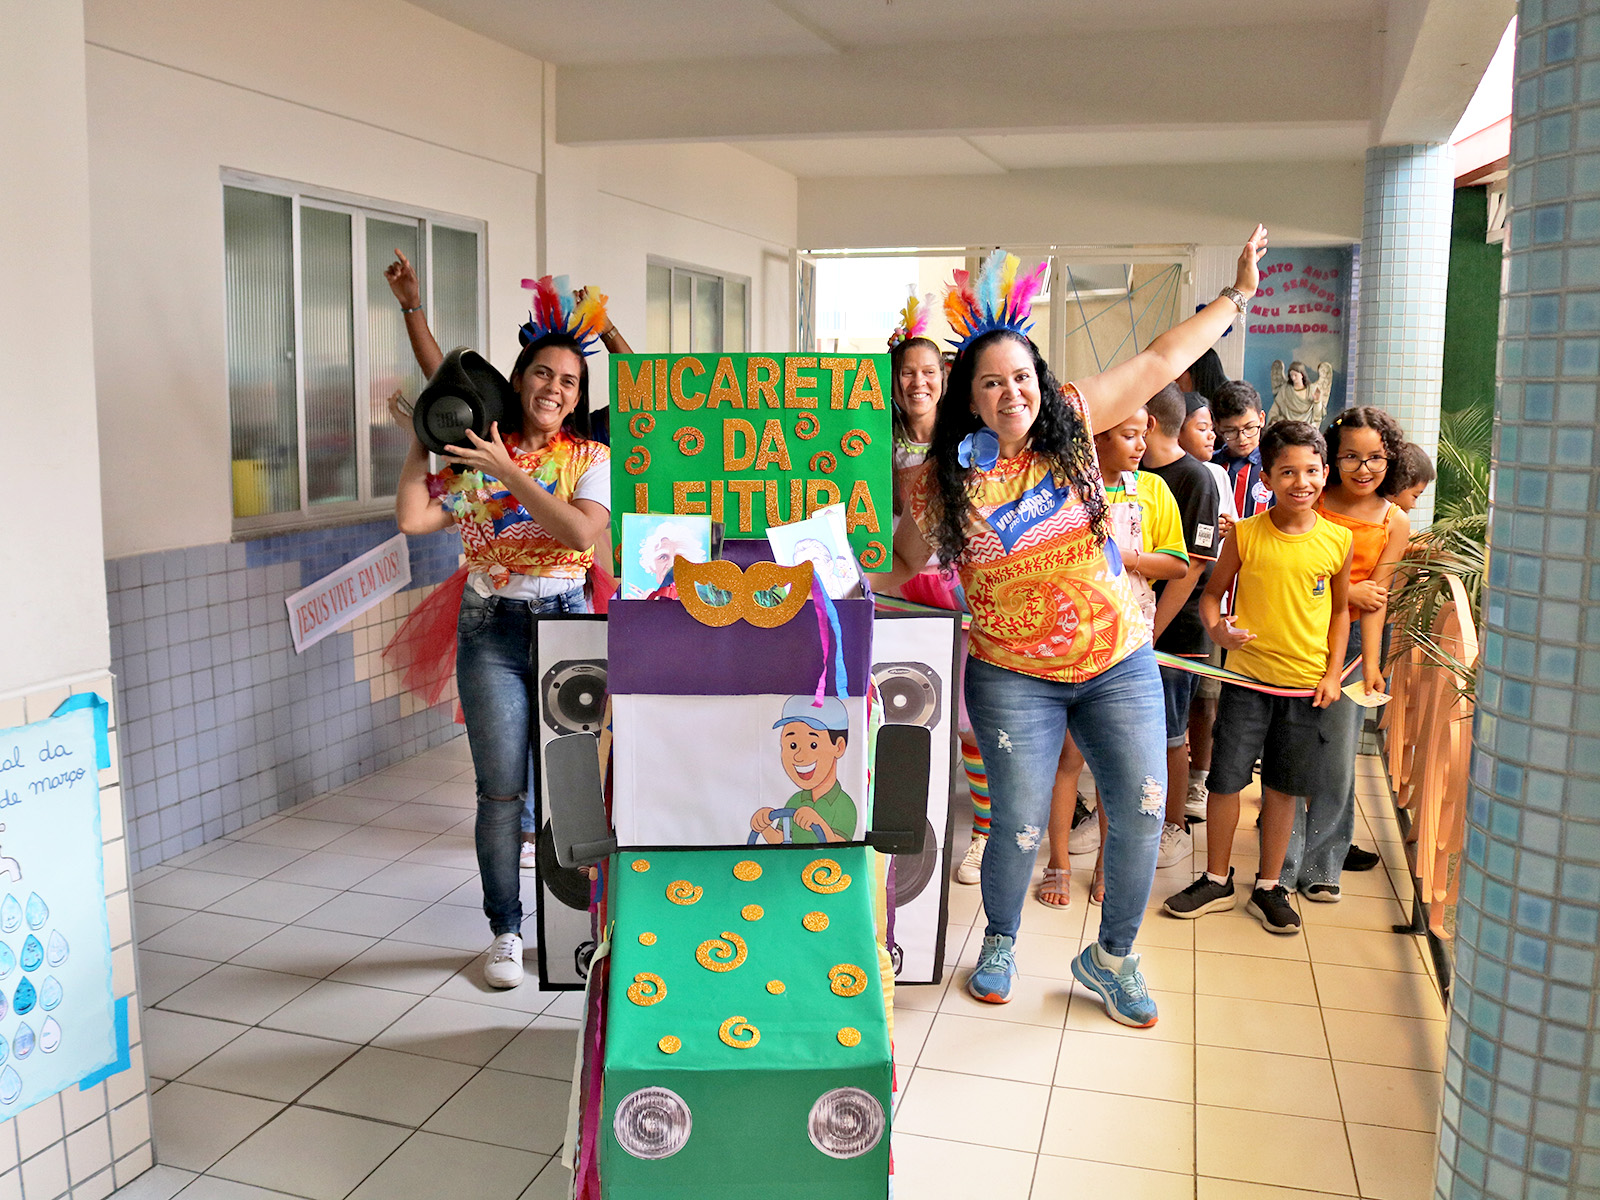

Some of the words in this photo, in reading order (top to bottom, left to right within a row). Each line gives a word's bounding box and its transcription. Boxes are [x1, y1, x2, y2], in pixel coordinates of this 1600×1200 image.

[1258, 262, 1294, 282] ANTO
[1255, 287, 1275, 298] DO
[1250, 305, 1280, 318] MEU
[1288, 302, 1341, 318] ZELOSO
[1249, 323, 1340, 335] GUARDADOR...
[617, 356, 886, 413] MICARETA
[436, 411, 463, 429] JBL
[723, 418, 792, 472] DA
[297, 594, 330, 643] JESUS
[329, 578, 358, 614] VIVE
[358, 566, 377, 597] EM
[0, 745, 25, 773] al
[39, 740, 73, 762] da
[0, 789, 22, 809] de
[28, 767, 86, 795] março
